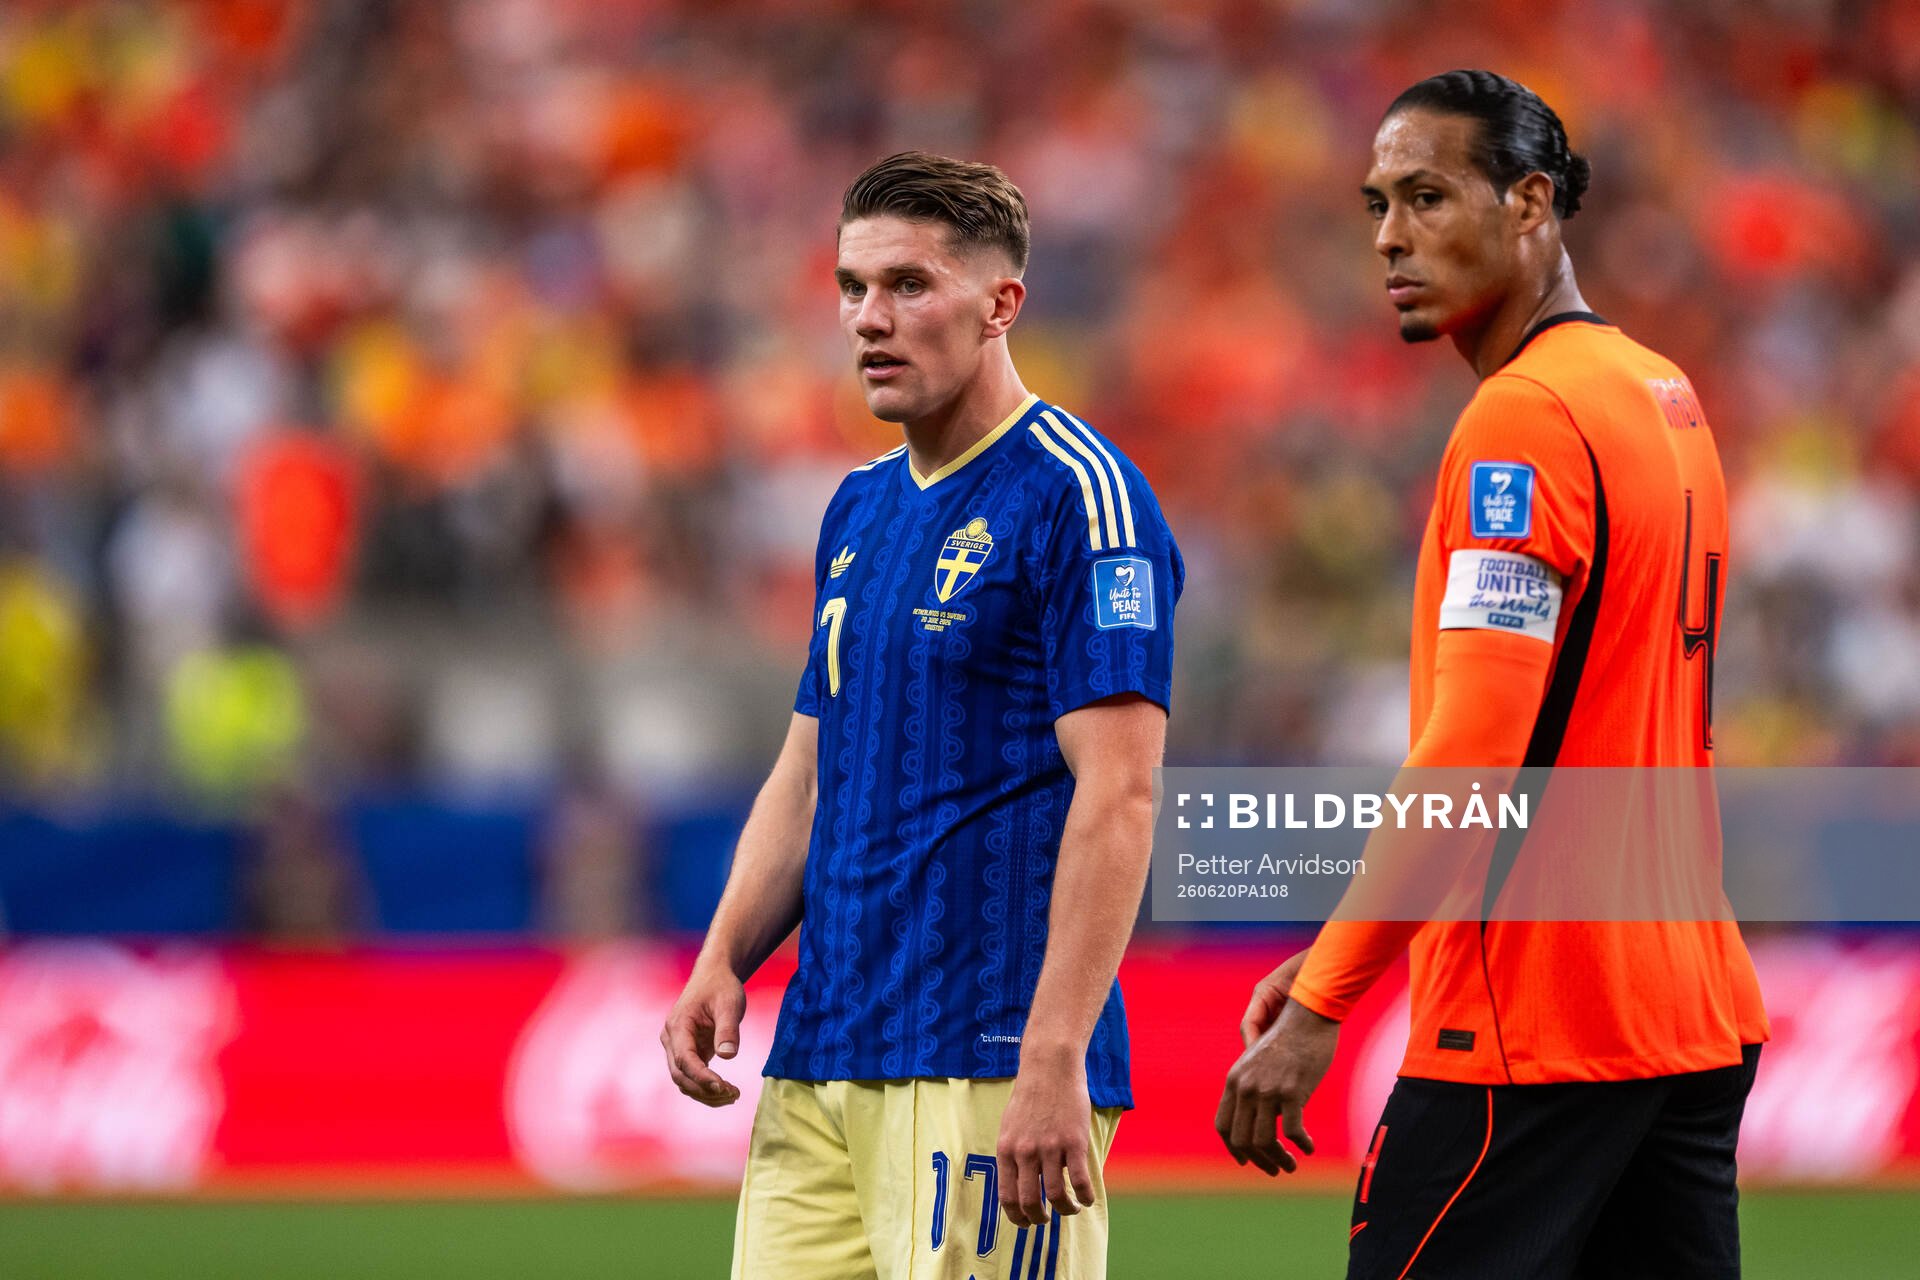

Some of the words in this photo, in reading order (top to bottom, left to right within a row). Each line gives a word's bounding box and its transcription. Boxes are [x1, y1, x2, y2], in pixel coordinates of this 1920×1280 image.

[951, 539, 985, 550] SVERIGE
[1479, 558, 1548, 580] FOOTBALL
[1109, 587, 1131, 601] Unite
[1131, 587, 1141, 599] To
[1477, 573, 1550, 601] UNITES
[1112, 600, 1141, 613] PEACE
[1469, 593, 1497, 609] the
[1500, 596, 1551, 621] World
[1678, 489, 1721, 750] 4
[931, 1151, 999, 1258] 17
